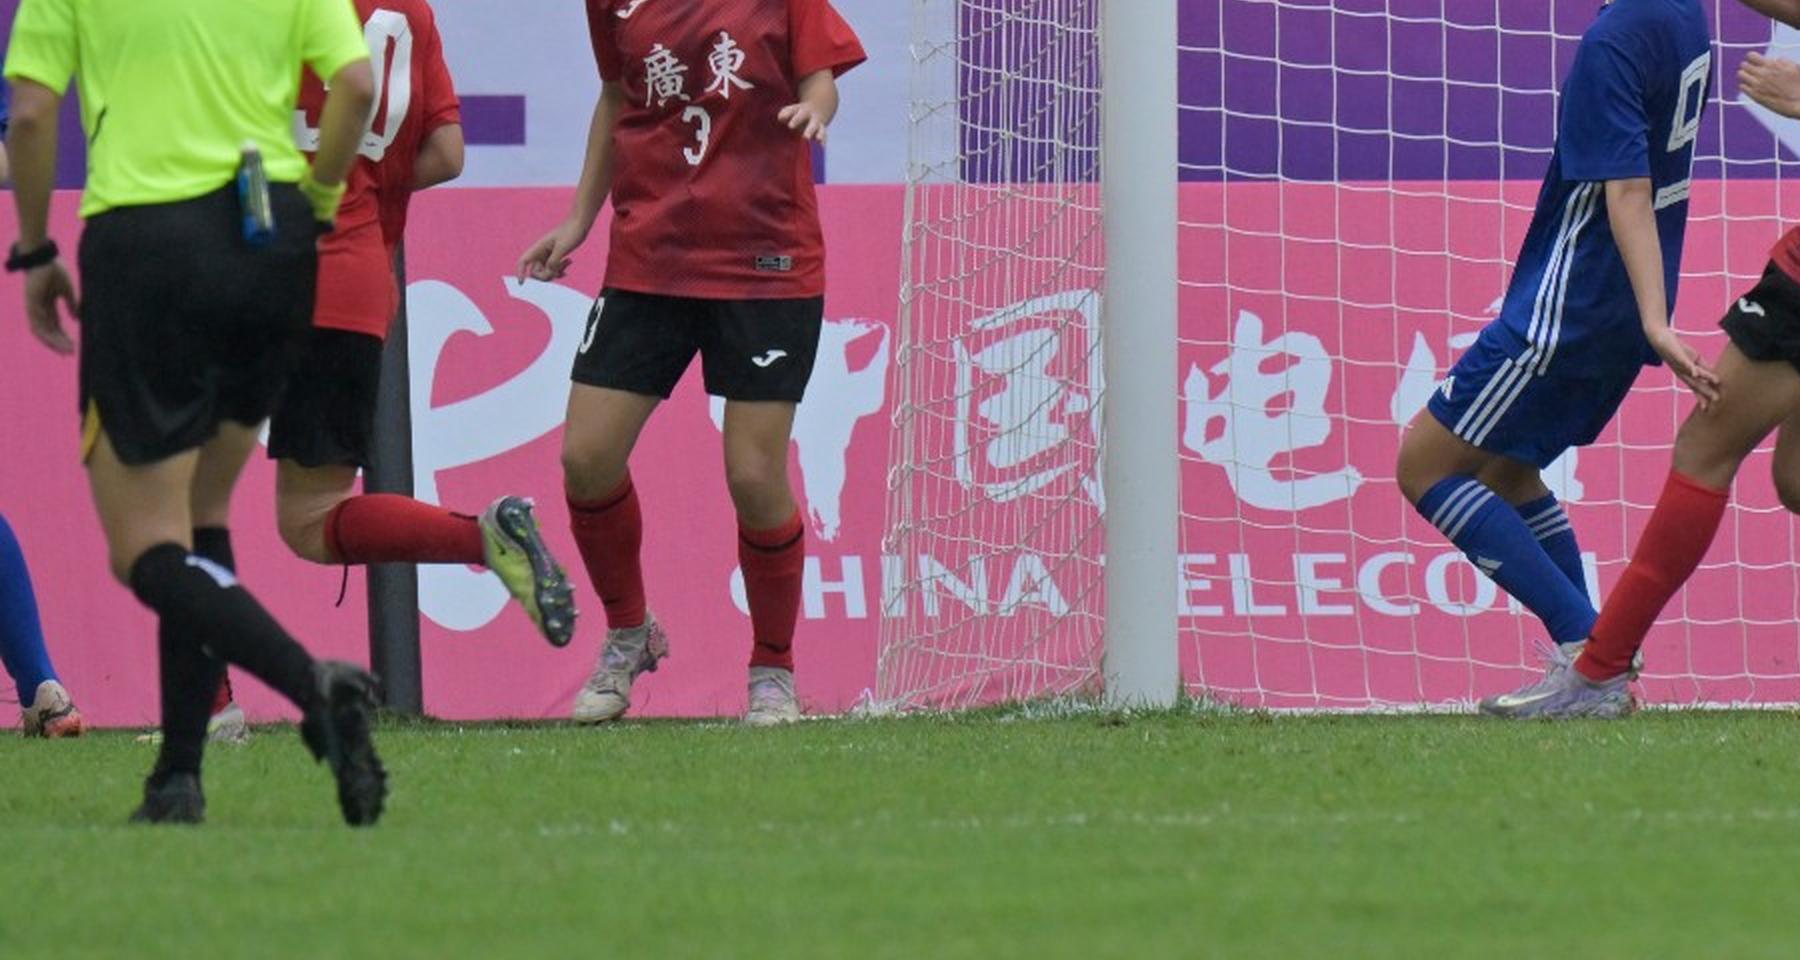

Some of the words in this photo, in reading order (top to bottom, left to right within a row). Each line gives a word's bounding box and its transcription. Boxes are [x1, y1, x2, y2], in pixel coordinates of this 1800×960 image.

[293, 7, 413, 163] 0
[642, 30, 756, 108] 廣東
[681, 105, 712, 166] 3
[1099, 550, 1602, 618] ELECO
